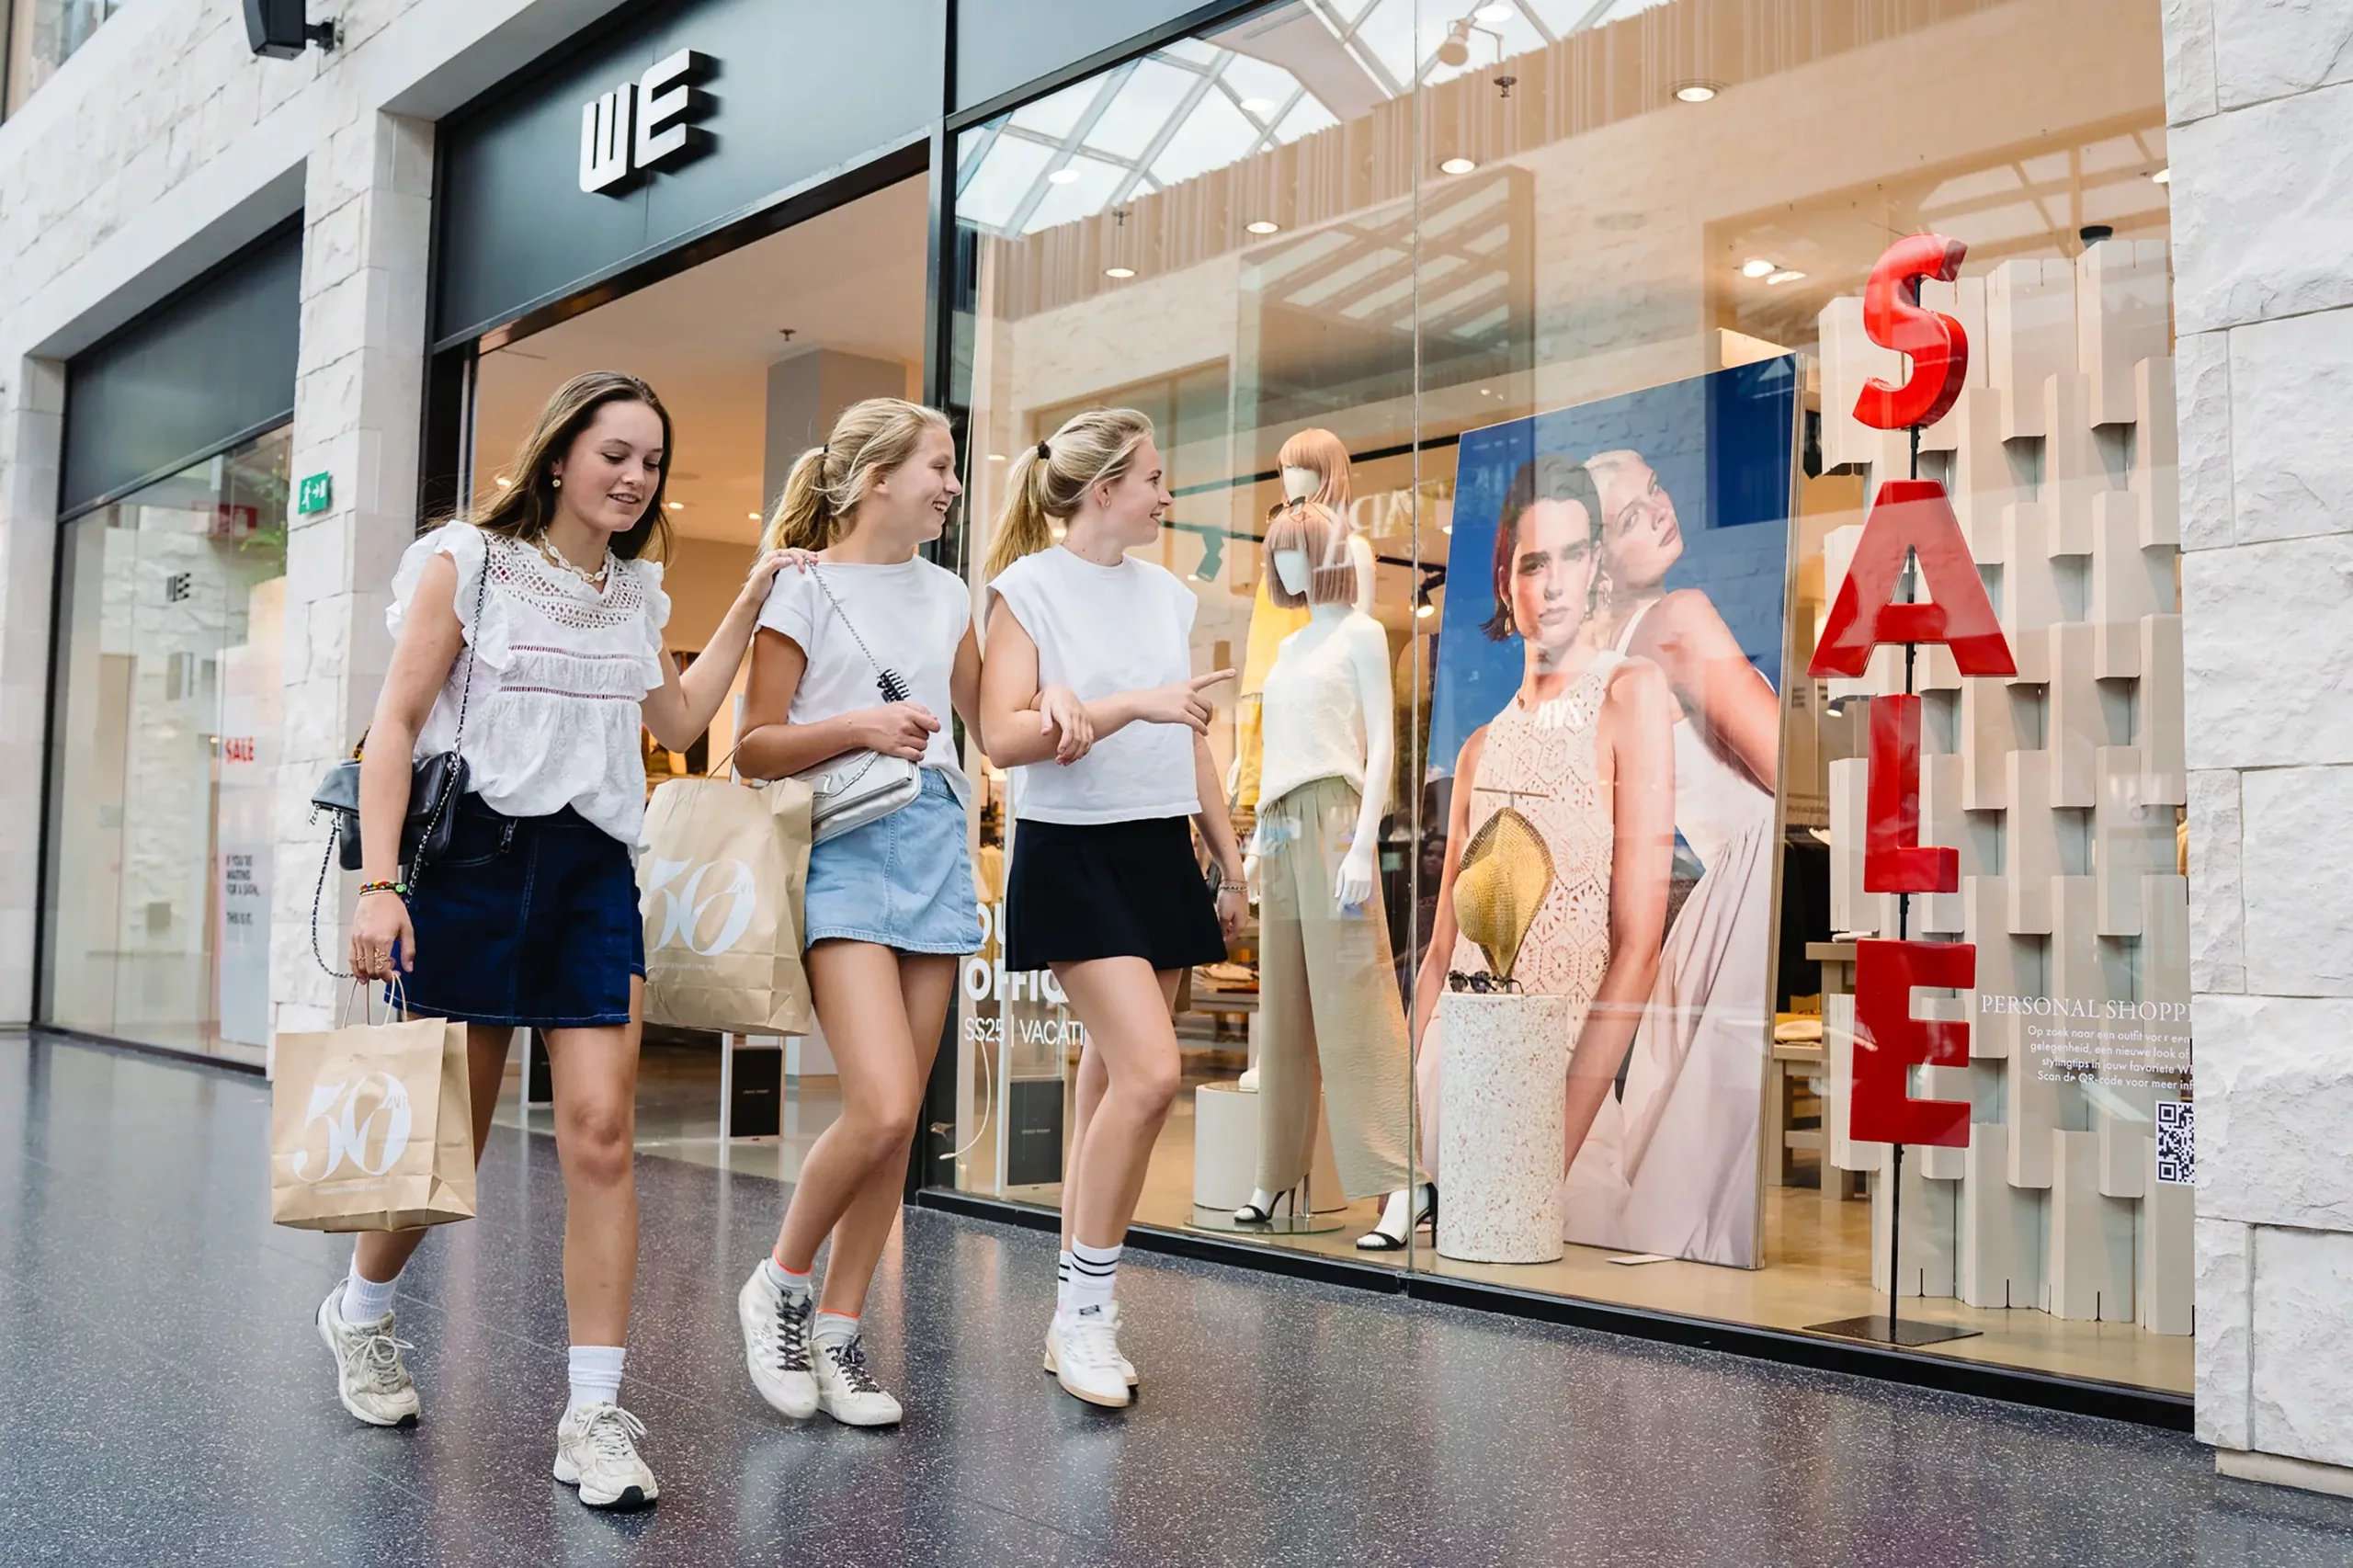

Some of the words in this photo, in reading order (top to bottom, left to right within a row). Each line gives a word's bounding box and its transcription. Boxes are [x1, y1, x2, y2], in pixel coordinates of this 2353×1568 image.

[579, 48, 690, 193] WE
[1808, 233, 2018, 1149] SALE
[225, 736, 255, 764] SALE
[1982, 994, 2099, 1018] PERSONAL
[964, 1017, 1006, 1042] SS25
[2028, 1026, 2043, 1038] Op
[2046, 1028, 2069, 1037] zoek
[2071, 1030, 2094, 1039] naar
[2097, 1031, 2115, 1040] een
[2118, 1030, 2143, 1041] outfit
[2091, 1059, 2100, 1068] in
[2095, 1047, 2113, 1055] een
[2115, 1046, 2151, 1057] nieuwe
[2154, 1047, 2177, 1059] look
[2038, 1070, 2061, 1081] Scan
[2078, 1073, 2123, 1085] QR-code
[2152, 1082, 2177, 1090] meer
[293, 1072, 412, 1182] 50
